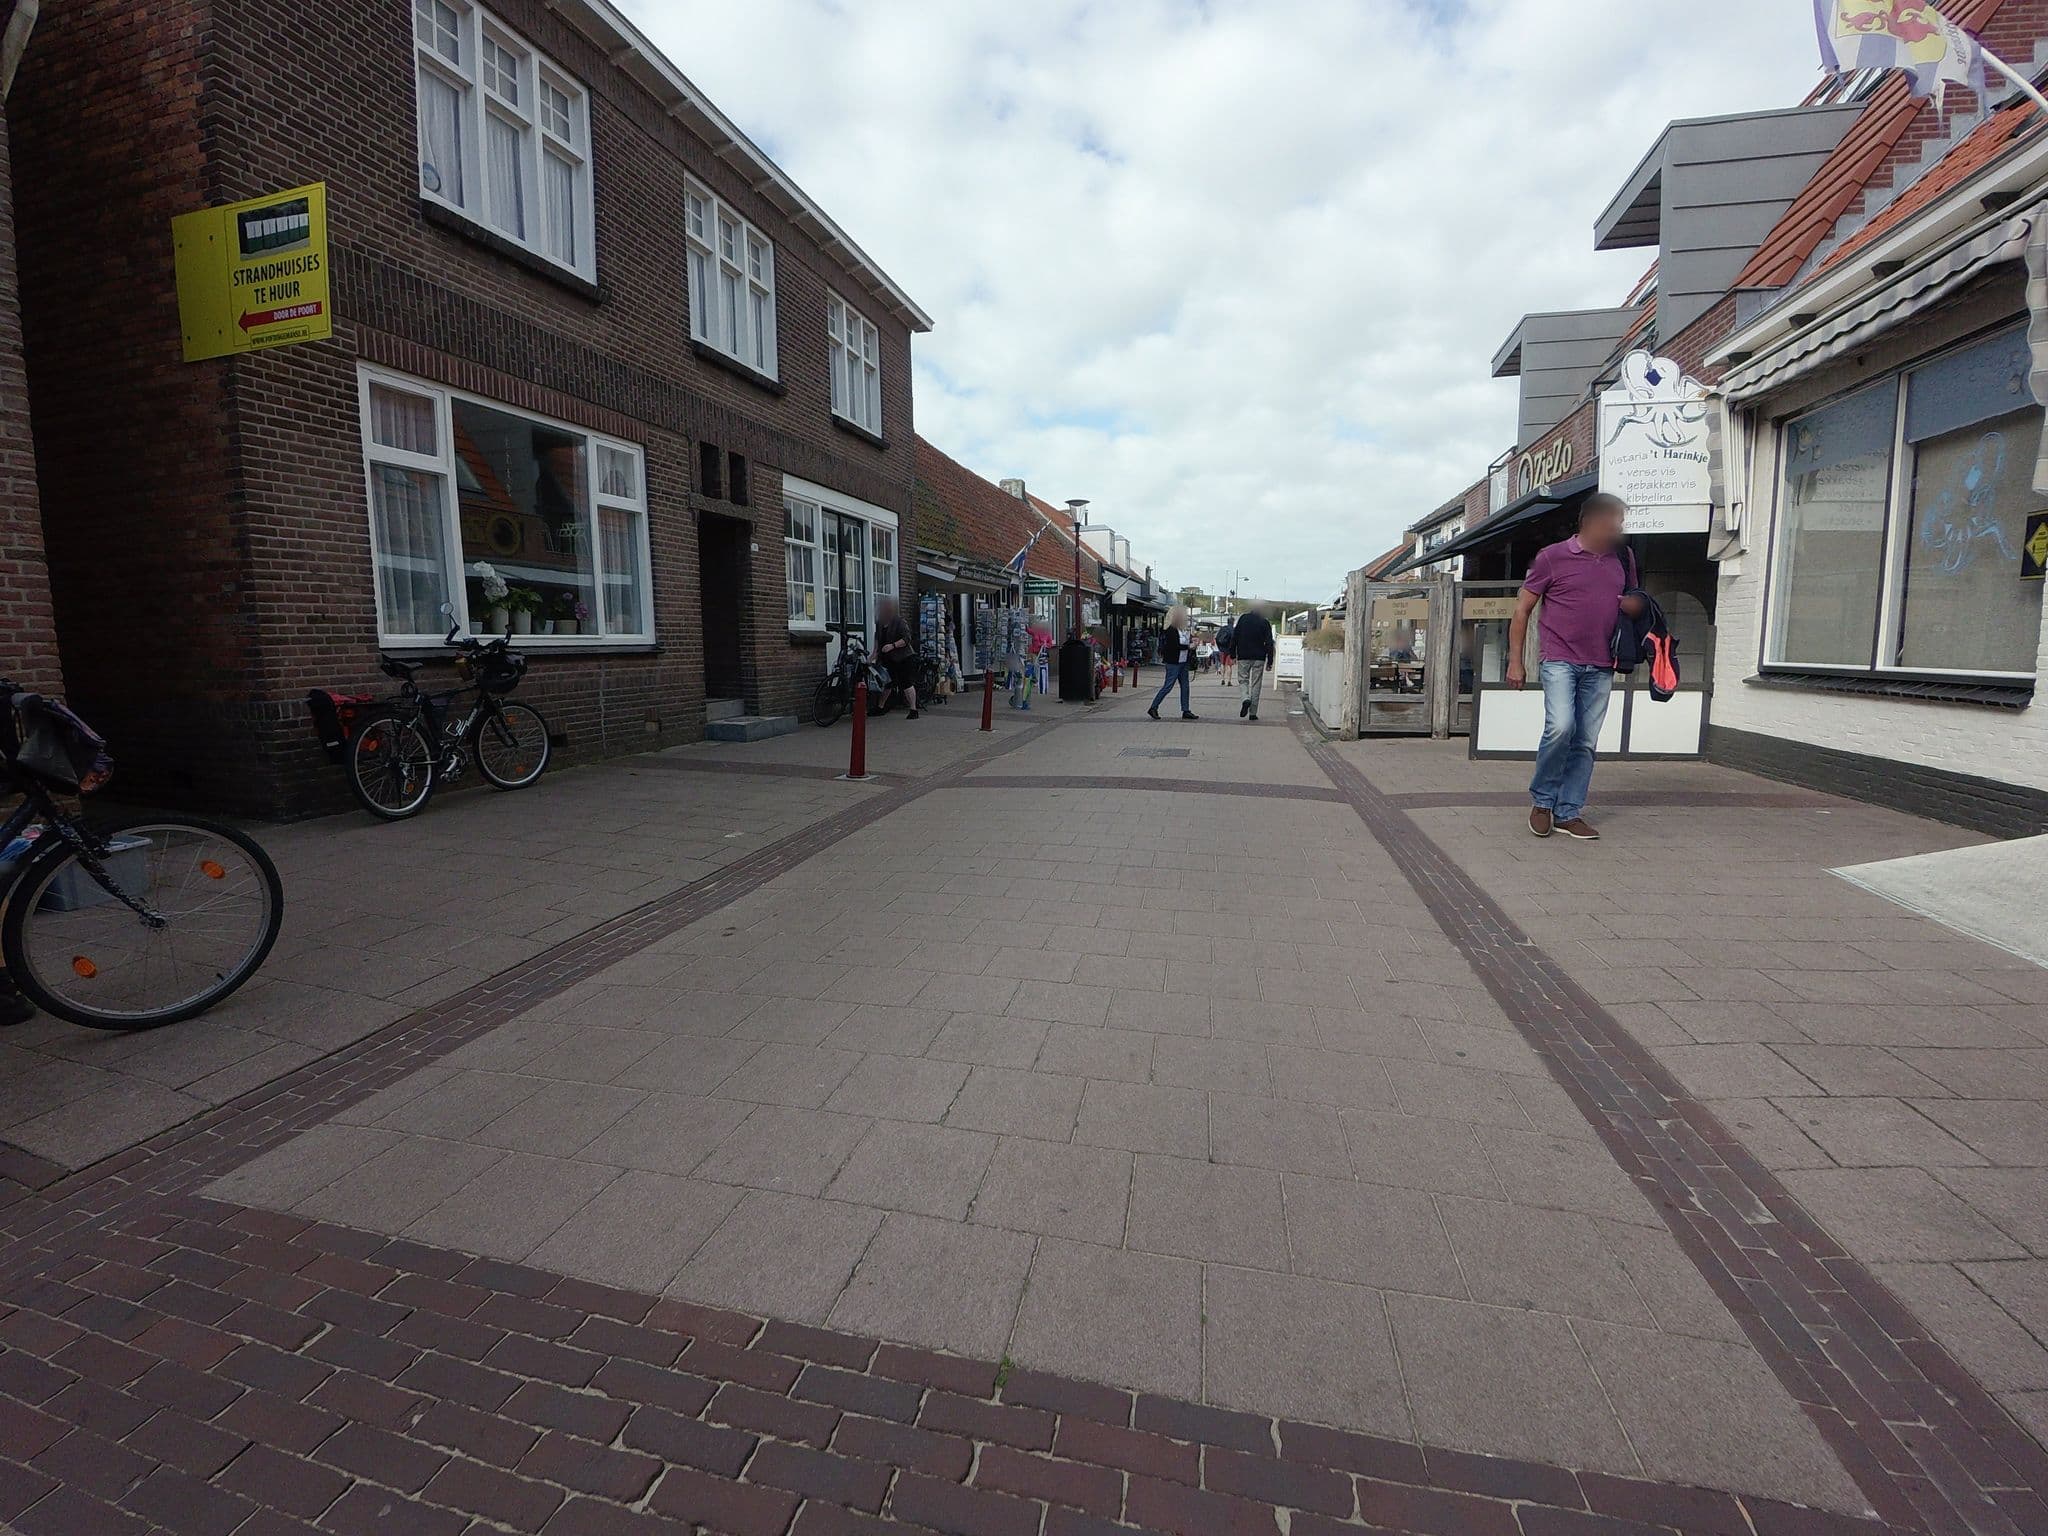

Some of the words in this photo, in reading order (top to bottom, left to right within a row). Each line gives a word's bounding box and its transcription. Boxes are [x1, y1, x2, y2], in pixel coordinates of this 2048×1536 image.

[233, 253, 320, 286] STRANDHUISJES
[254, 287, 266, 304] TE
[270, 281, 300, 301] HUUR
[273, 309, 289, 320] DOOR
[289, 308, 297, 317] DE
[297, 304, 317, 317] POORT
[1663, 449, 1709, 463] Harinkje
[1626, 468, 1658, 477] verse
[1626, 480, 1678, 492] gebakken
[1680, 481, 1697, 489] vis
[1624, 519, 1665, 529] snacks
